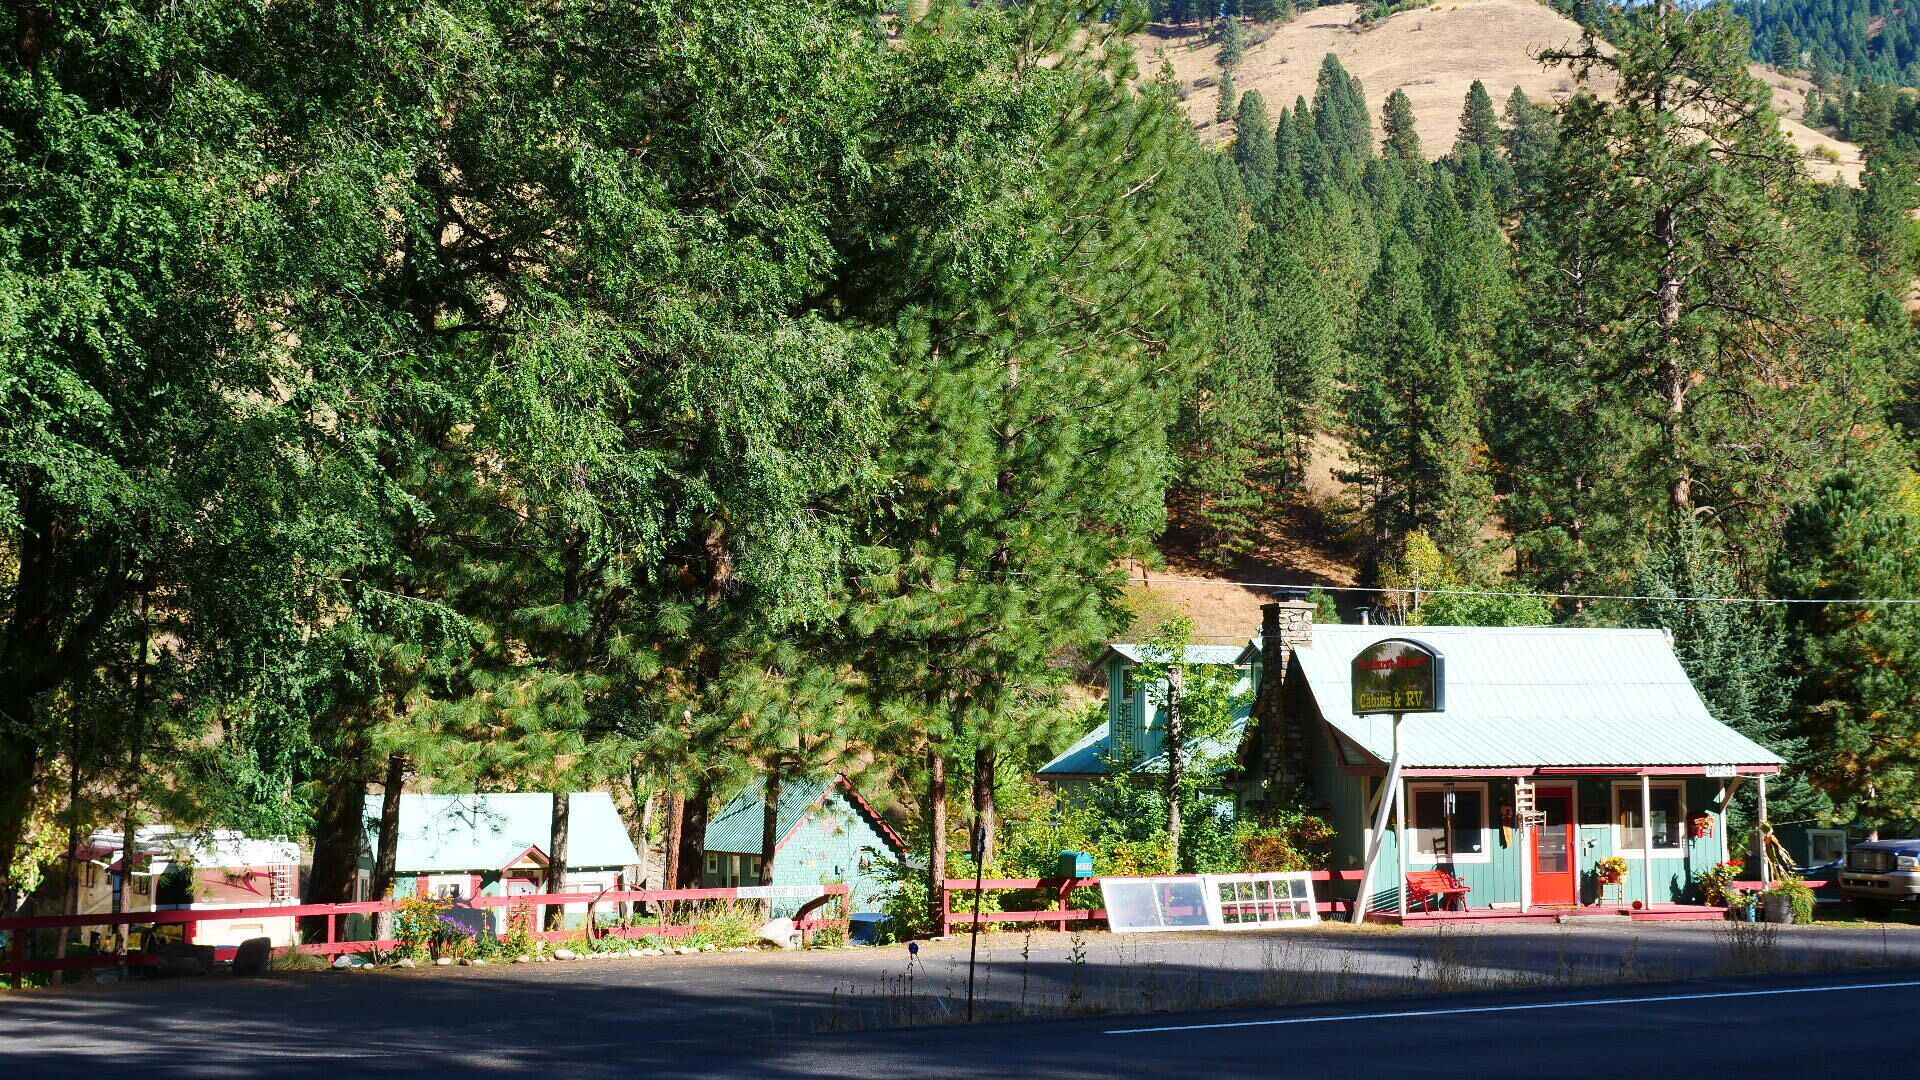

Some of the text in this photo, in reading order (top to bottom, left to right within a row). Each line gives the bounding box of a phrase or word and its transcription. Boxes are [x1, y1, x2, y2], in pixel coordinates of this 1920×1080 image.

[1360, 690, 1424, 709] Cabins & RV
